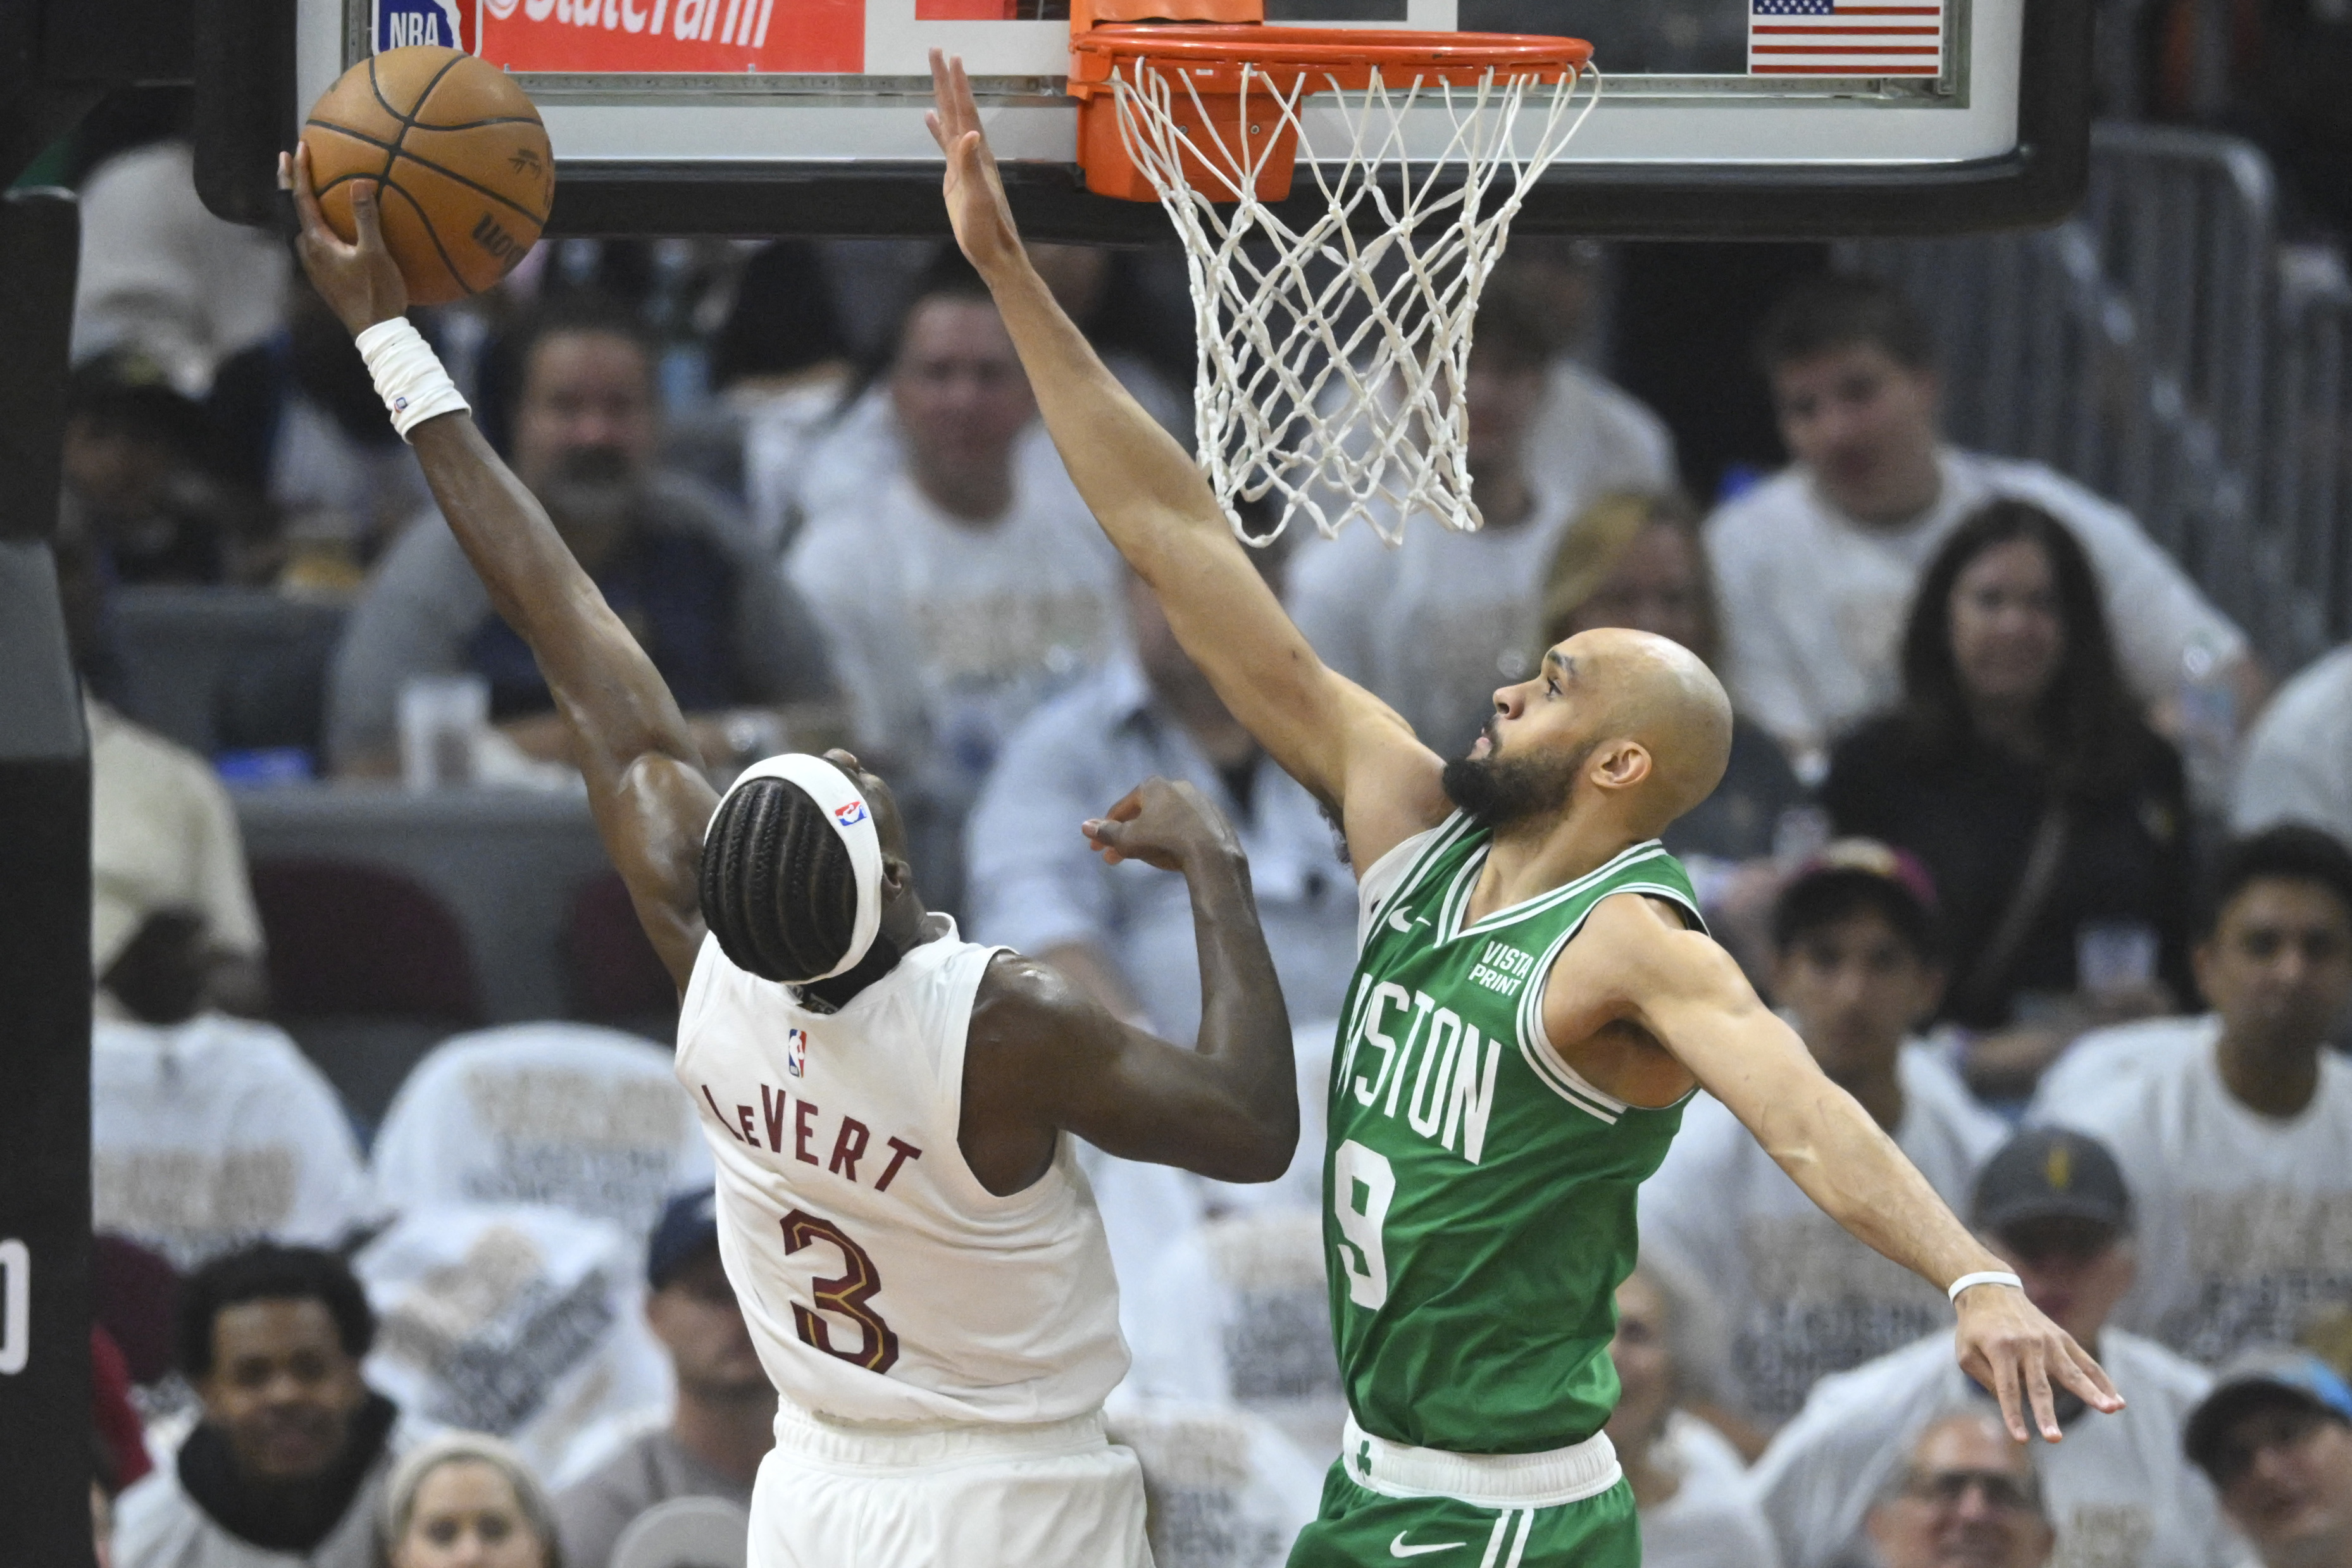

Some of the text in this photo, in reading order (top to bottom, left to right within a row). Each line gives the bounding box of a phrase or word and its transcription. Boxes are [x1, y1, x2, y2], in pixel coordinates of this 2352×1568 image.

[390, 12, 439, 50] NBA
[1469, 963, 1522, 996] PRINT
[1482, 941, 1534, 980] VISTA
[1336, 972, 1502, 1166] STON
[1335, 1139, 1396, 1311] 9
[780, 1208, 899, 1375] 3
